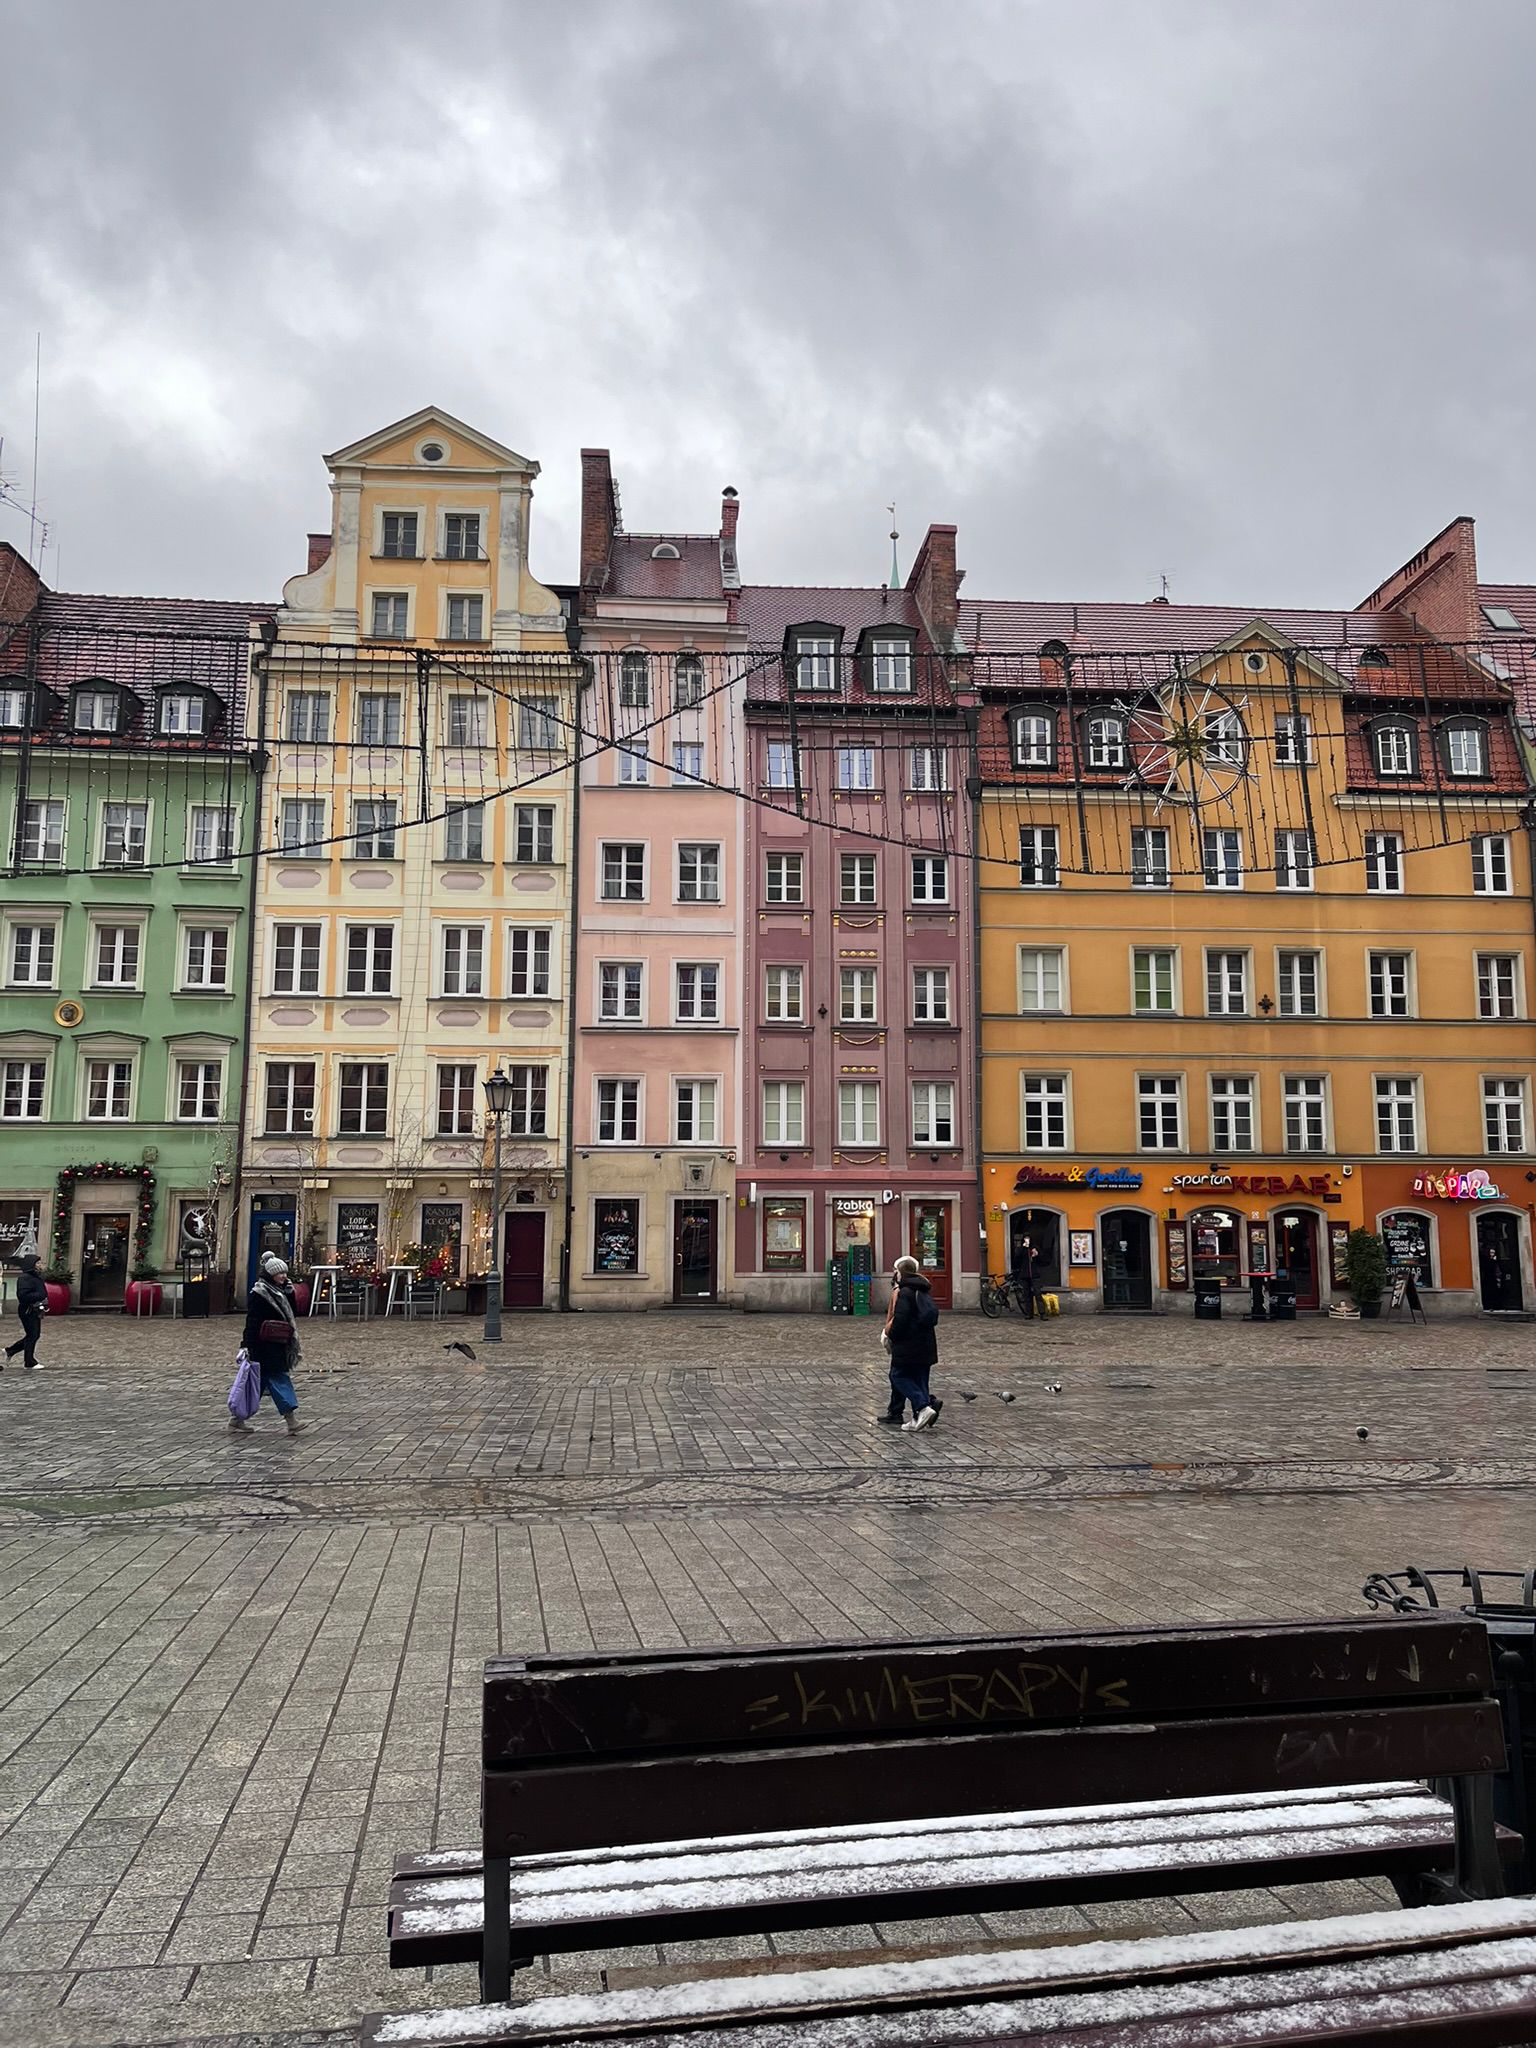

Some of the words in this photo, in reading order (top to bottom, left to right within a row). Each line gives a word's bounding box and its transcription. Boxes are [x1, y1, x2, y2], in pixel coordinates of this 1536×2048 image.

[1067, 1166, 1083, 1182] &
[1173, 1174, 1233, 1187] spartan
[1232, 1175, 1330, 1195] KEBAB
[1413, 1176, 1497, 1198] DISPARO
[837, 1199, 873, 1211] żabka
